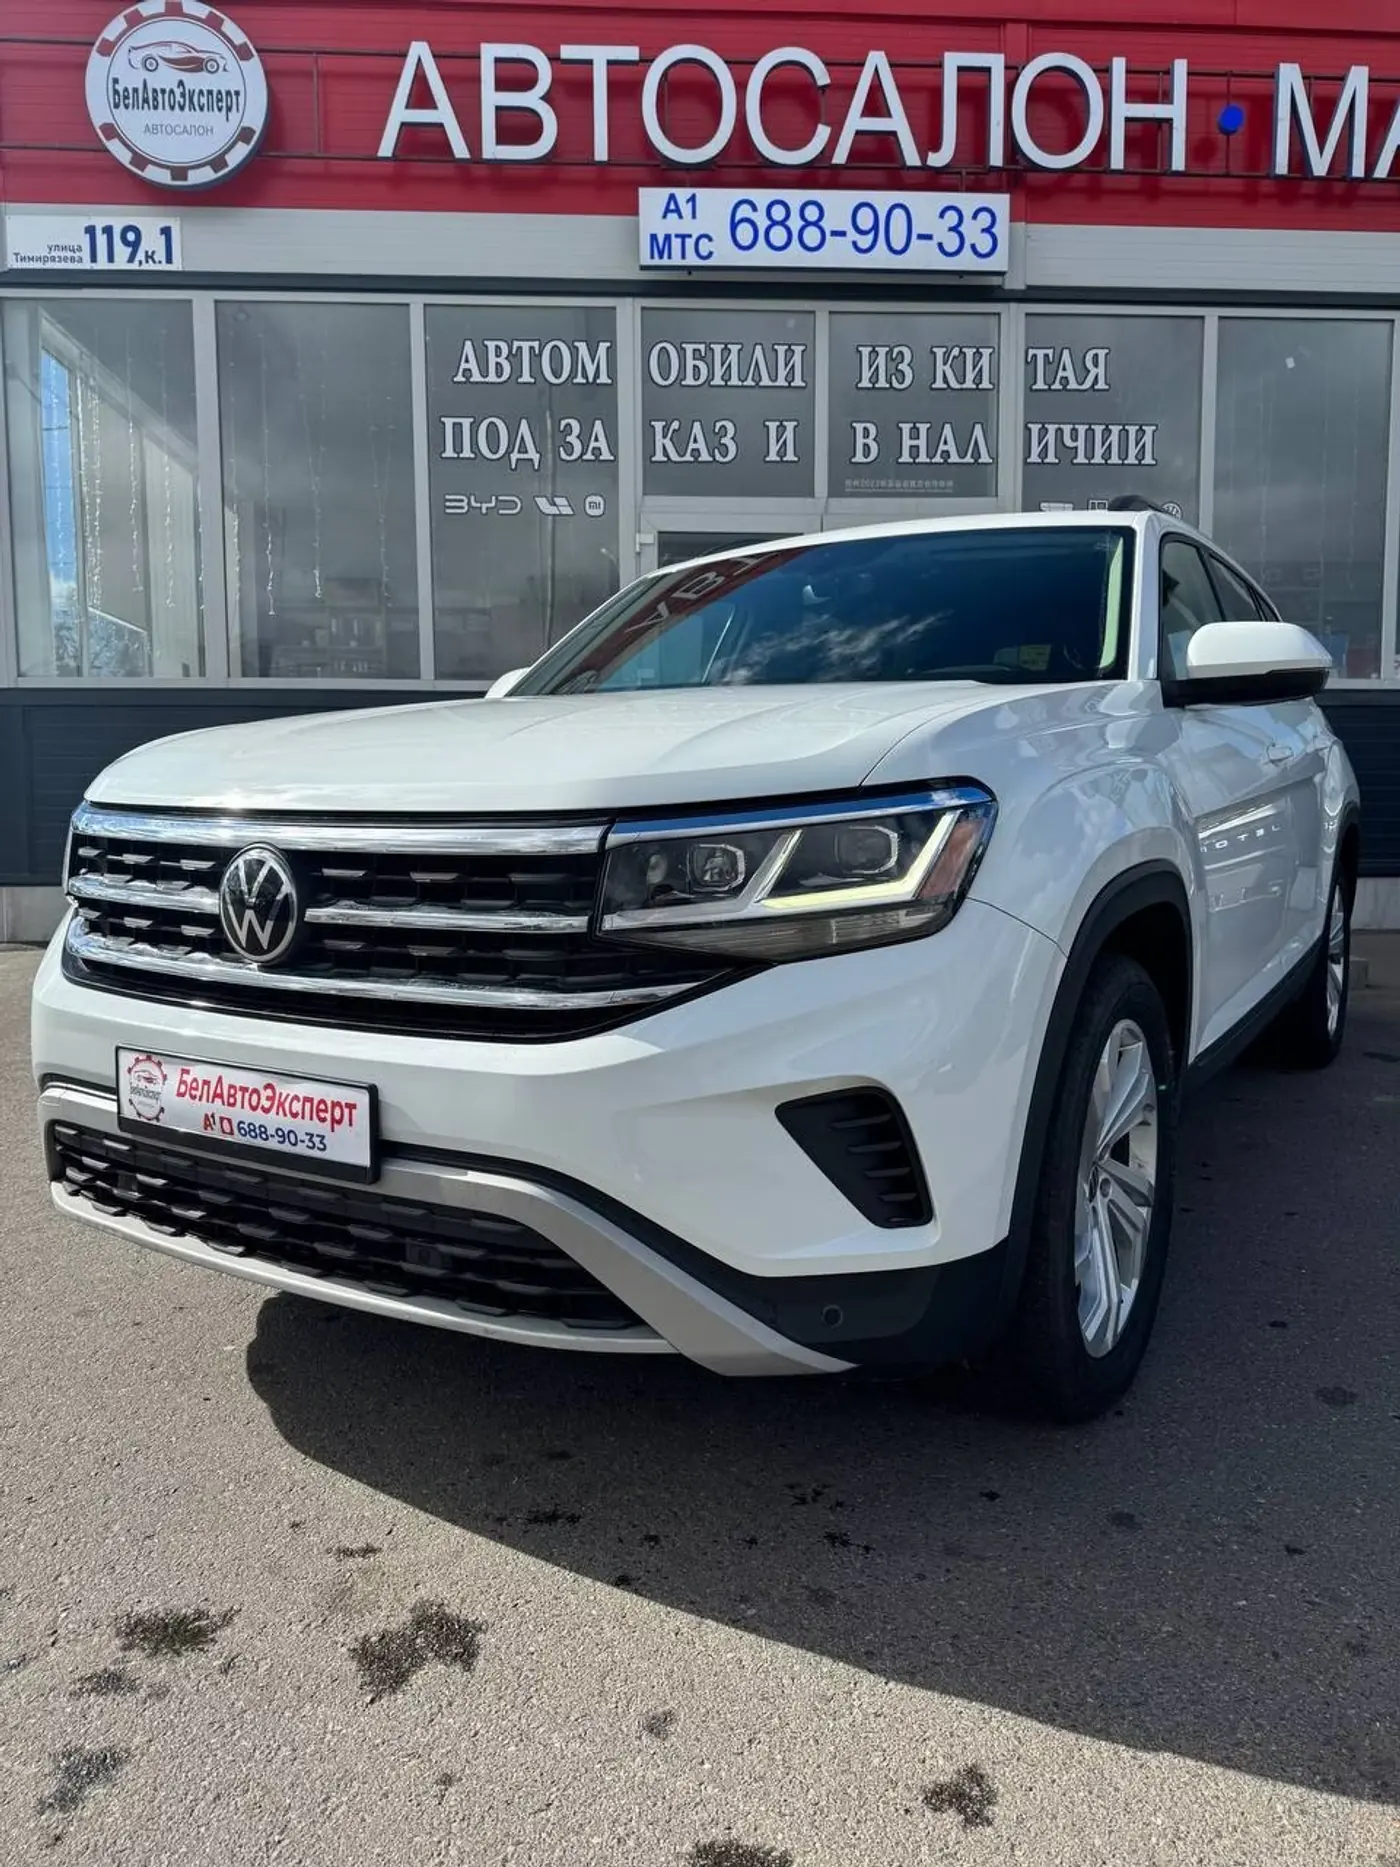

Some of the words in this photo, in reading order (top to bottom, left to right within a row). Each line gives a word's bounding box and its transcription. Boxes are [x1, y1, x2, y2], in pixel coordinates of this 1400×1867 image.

[110, 77, 242, 121] БелАвтоЭксперт
[377, 41, 1188, 172] АВТОСАЛОН
[143, 122, 214, 137] АВТОСАЛОН
[46, 242, 84, 255] улица
[648, 232, 715, 262] МТС
[728, 198, 999, 260] 688-90-33
[12, 251, 84, 266] Тимирязева
[856, 345, 914, 390] ИЗ
[439, 415, 541, 471] ПОД
[764, 420, 800, 463] И
[850, 420, 880, 464] В
[175, 1067, 358, 1133] БелАвтоЭксперт
[236, 1120, 328, 1152] 688-90-33
